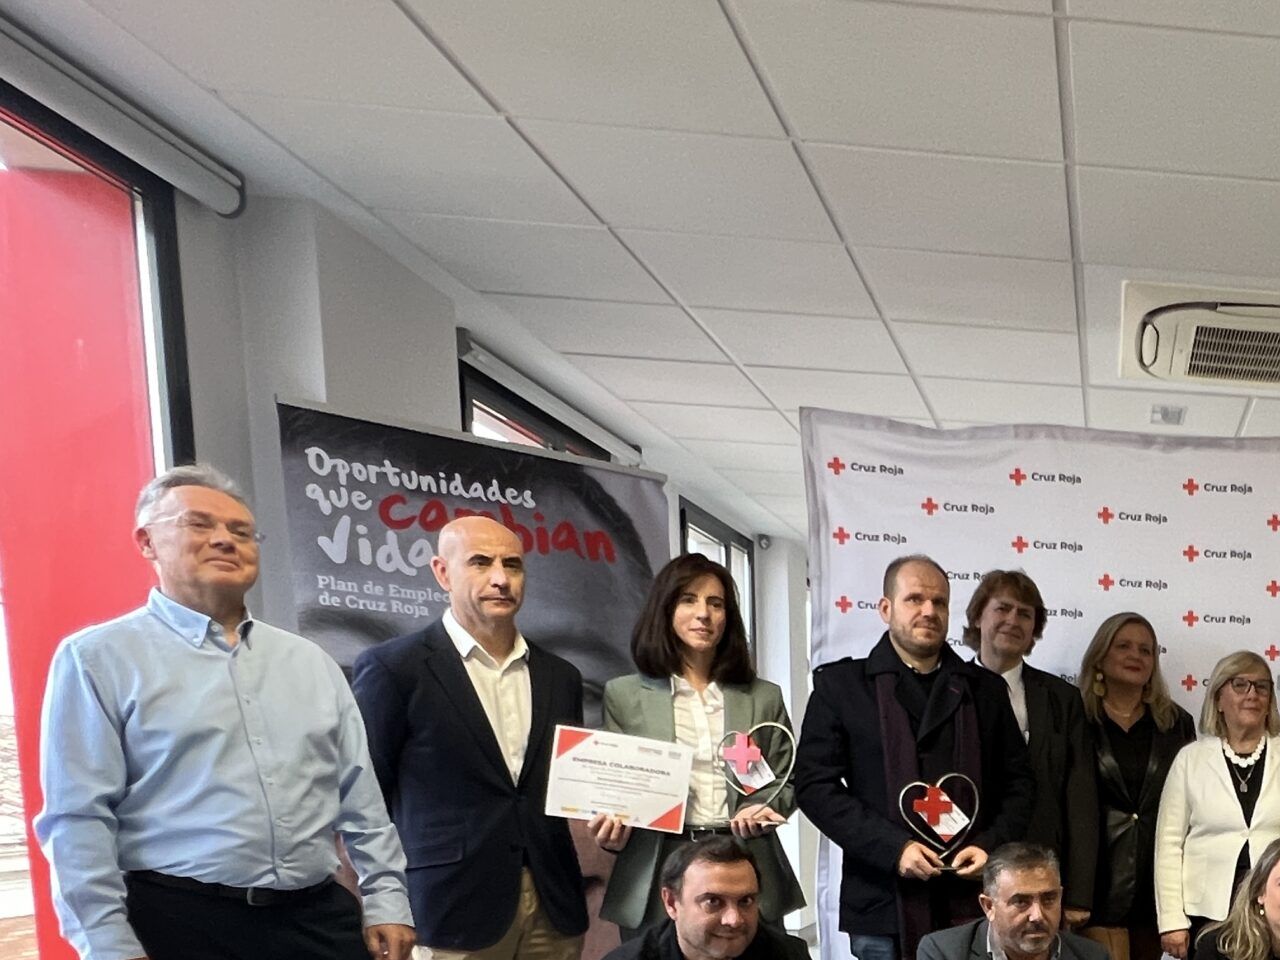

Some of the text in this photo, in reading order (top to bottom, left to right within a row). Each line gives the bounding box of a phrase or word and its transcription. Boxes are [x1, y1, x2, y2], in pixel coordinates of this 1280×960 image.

[850, 462, 904, 477] Cruz Roja
[304, 446, 536, 509] Oportunidades
[1031, 471, 1082, 486] Cruz Roja
[1203, 482, 1253, 496] Cruz Roja
[942, 502, 995, 516] Cruz Roja
[305, 483, 617, 565] que cabian
[1118, 511, 1168, 525] Cruz Roja
[854, 531, 907, 545] Cruz Roja
[317, 515, 434, 577] Vida
[1032, 540, 1084, 553] Cruz Roja
[1203, 549, 1252, 561] Cruz Roja
[316, 574, 359, 593] Plan
[363, 581, 384, 596] de
[1118, 578, 1168, 591] Cruz Roja
[318, 591, 429, 618] de Cruz Roja
[857, 600, 879, 610] Cru
[1060, 608, 1084, 620] Roja
[1203, 614, 1251, 626] Cruz Roja
[572, 757, 607, 766] EMPRESA
[609, 762, 671, 776] COLABORADORA
